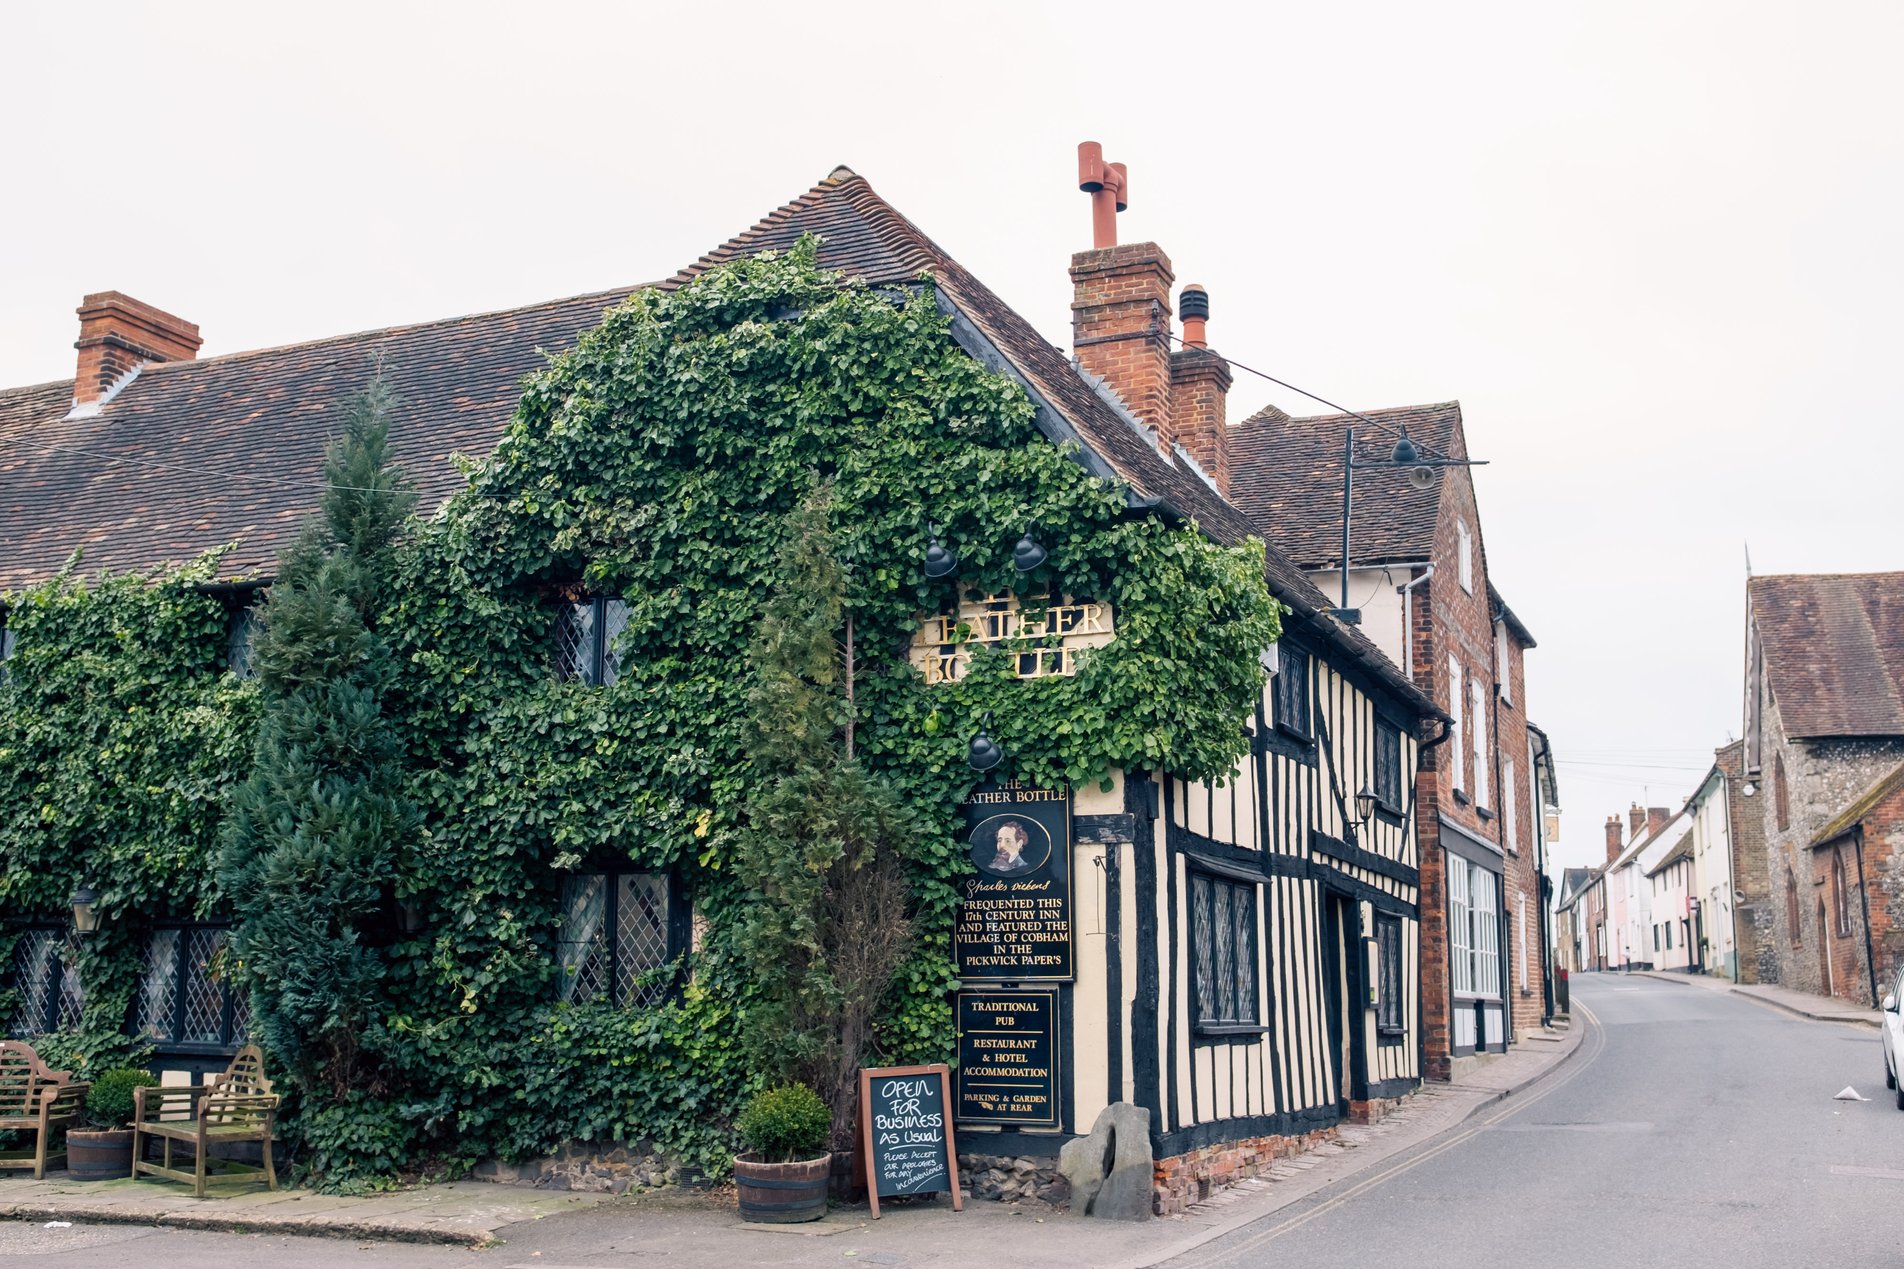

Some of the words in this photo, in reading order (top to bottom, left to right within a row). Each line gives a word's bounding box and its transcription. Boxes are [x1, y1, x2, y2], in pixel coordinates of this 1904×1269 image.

[961, 791, 1011, 805] EATHER
[1016, 790, 1066, 802] BOTTLE
[1011, 880, 1051, 892] Dickens
[963, 899, 1034, 911] FREQUENTED
[1037, 898, 1062, 908] THIS
[965, 912, 982, 921] 17th
[985, 910, 1036, 920] CENTURY
[1039, 909, 1060, 919] INN
[958, 923, 982, 932] AND
[986, 922, 1042, 932] FEATURED
[1045, 921, 1068, 931] THE
[956, 933, 1001, 943] VILLAGE
[1003, 933, 1018, 943] OF
[1020, 932, 1068, 942] COBHAM
[993, 945, 1006, 954] IN
[1009, 944, 1033, 954] THE
[966, 956, 1018, 966] PICKWICK
[1021, 955, 1062, 965] PAPER'S
[971, 1002, 1039, 1012] TRADITIONAL
[995, 1016, 1015, 1026] PUB
[973, 1039, 1037, 1049] RESTAURANT
[982, 1054, 990, 1062] &
[995, 1053, 1028, 1063] HOTEL
[963, 1067, 1048, 1077] ACCOMMODATION
[881, 1080, 933, 1098] OPEN
[964, 1093, 1000, 1102] PARKING
[1013, 1094, 1047, 1103] GARDEN
[889, 1098, 921, 1116] FOR
[997, 1103, 1007, 1111] AT
[1010, 1104, 1032, 1112] REAR
[875, 1113, 942, 1129] BUSINESS
[911, 1150, 937, 1159] ACCEPT
[884, 1163, 898, 1171] OUR
[884, 1171, 897, 1179] FOR
[898, 1169, 912, 1178] ANY
